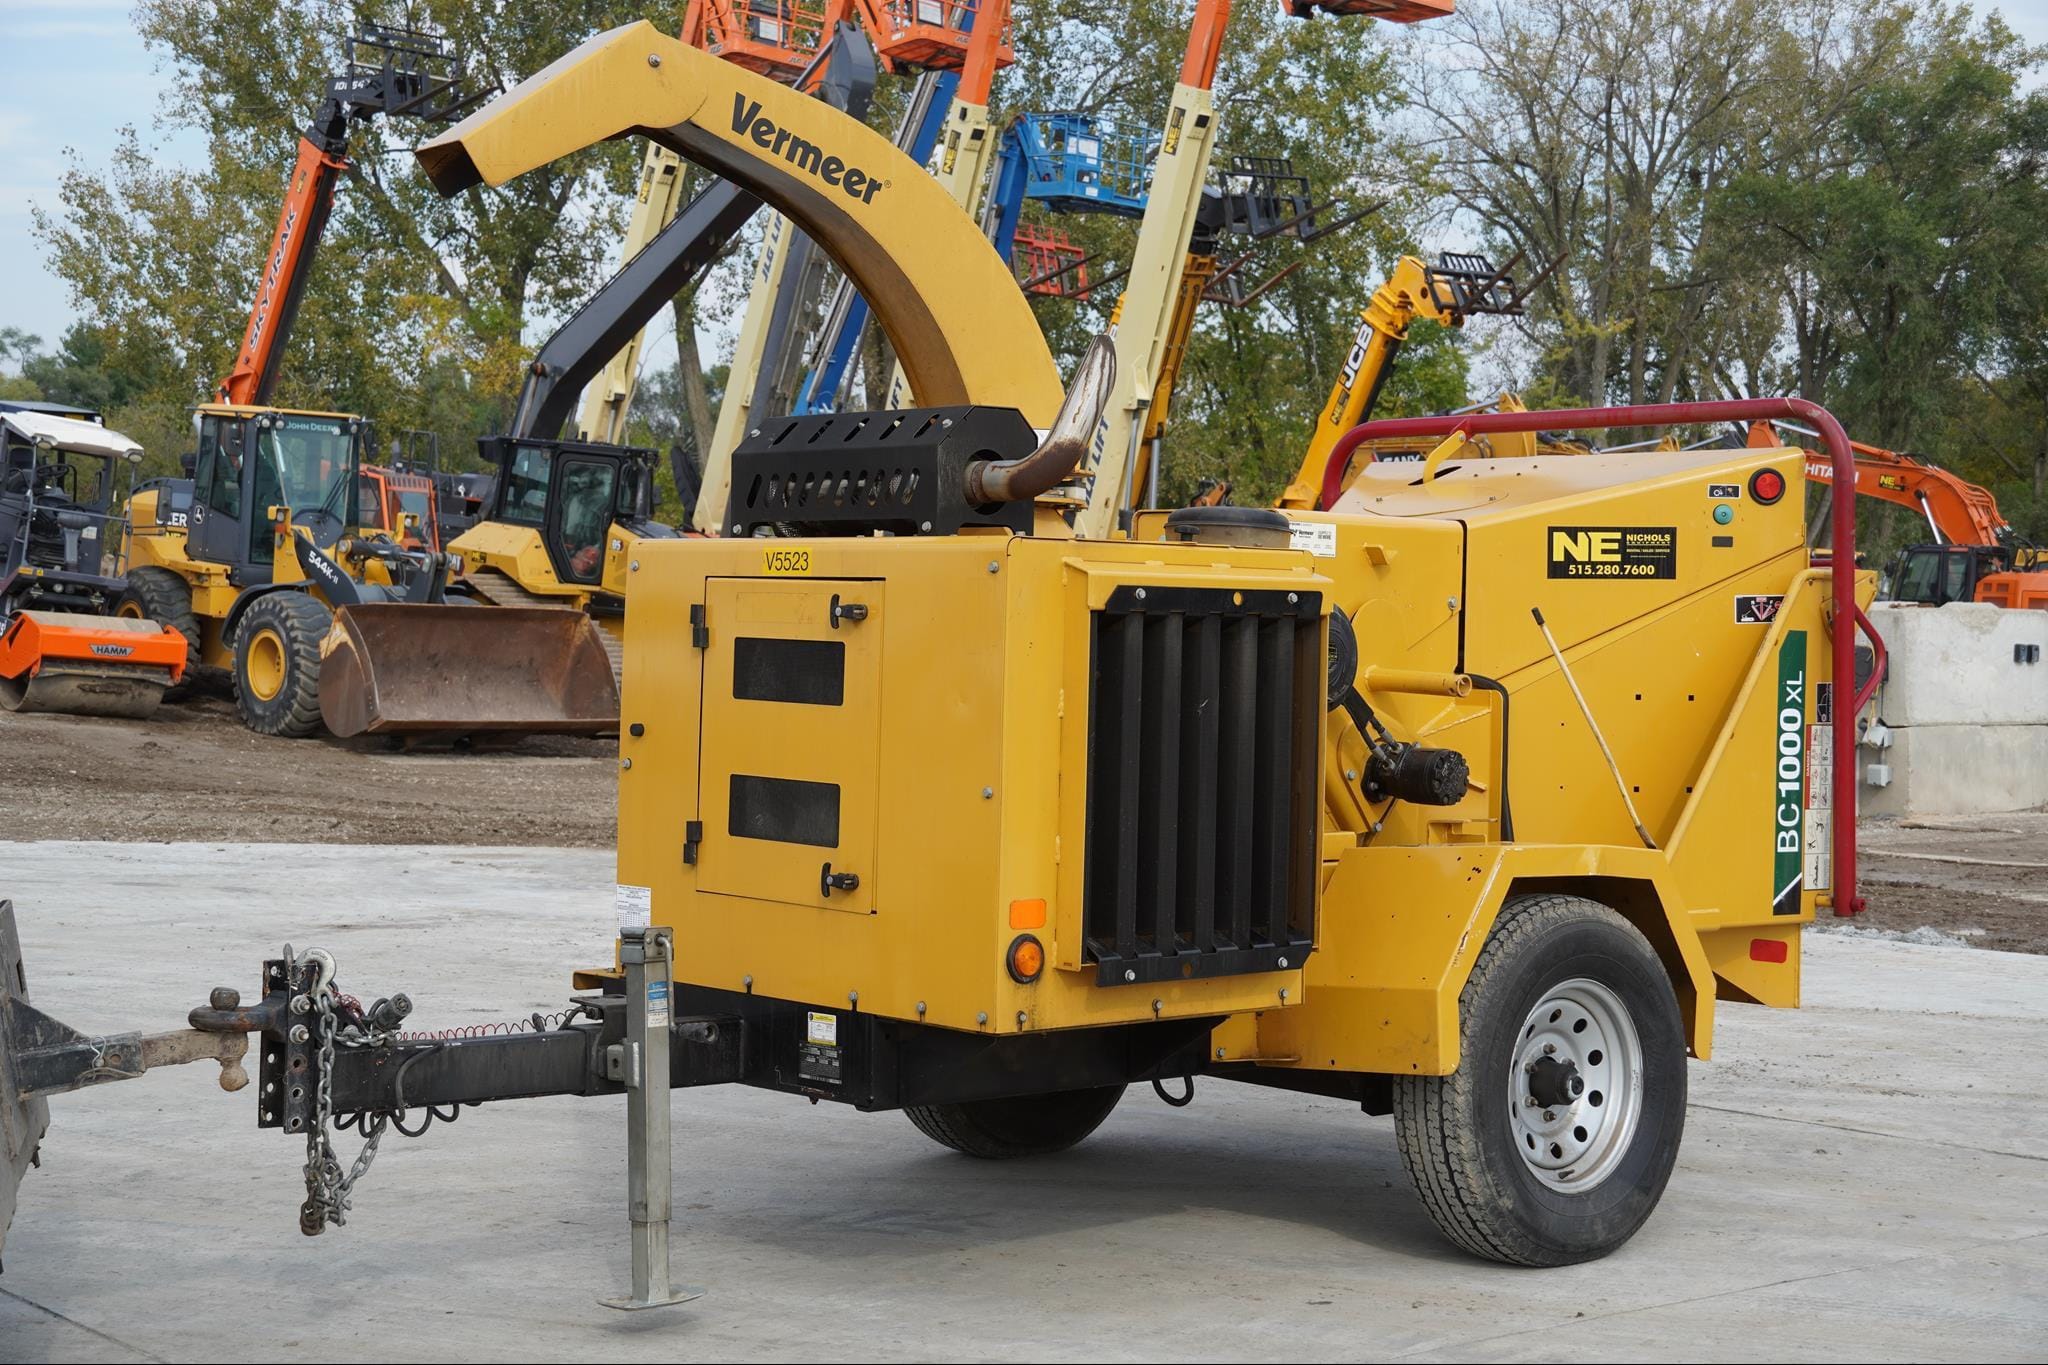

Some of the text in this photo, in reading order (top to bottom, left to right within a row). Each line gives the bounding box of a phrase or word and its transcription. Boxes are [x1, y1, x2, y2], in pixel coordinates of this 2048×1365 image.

[731, 91, 883, 205] Vermeer
[762, 212, 782, 284] JLG LIF
[250, 202, 296, 352] SKYTRAK
[1344, 322, 1374, 389] JCB
[891, 376, 902, 410] IFT
[286, 421, 309, 430] JOHN
[1092, 415, 1109, 467] LIFT
[1804, 462, 1859, 484] HITAI
[1880, 475, 1895, 486] NE
[1553, 532, 1621, 561] NE
[1626, 533, 1671, 541] NICHOLS
[765, 551, 809, 571] V5523
[1568, 564, 1655, 576] 515.280.7600
[97, 645, 127, 656] HAMM
